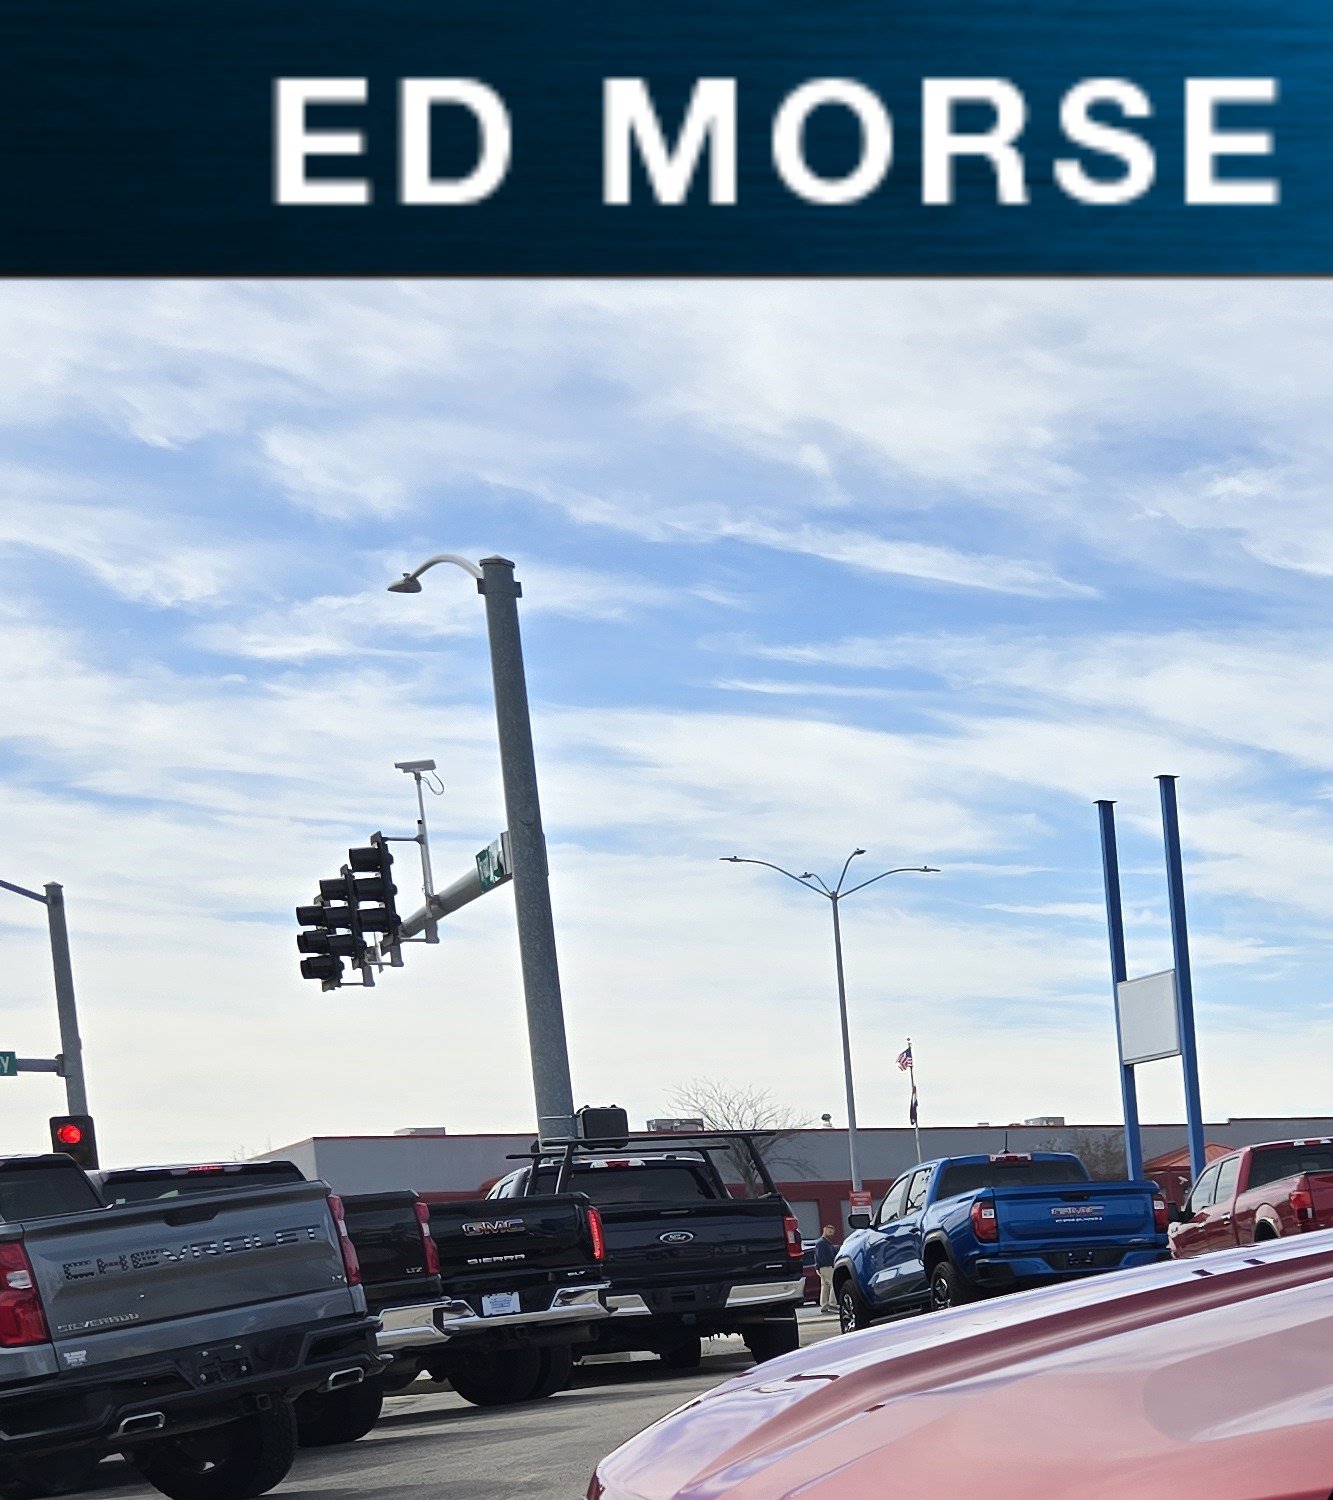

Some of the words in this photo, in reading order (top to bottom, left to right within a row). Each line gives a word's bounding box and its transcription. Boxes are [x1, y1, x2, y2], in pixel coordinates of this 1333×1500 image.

[461, 1218, 526, 1237] GMC
[62, 1223, 321, 1281] CHEVROLET
[466, 1253, 526, 1266] SIERRA
